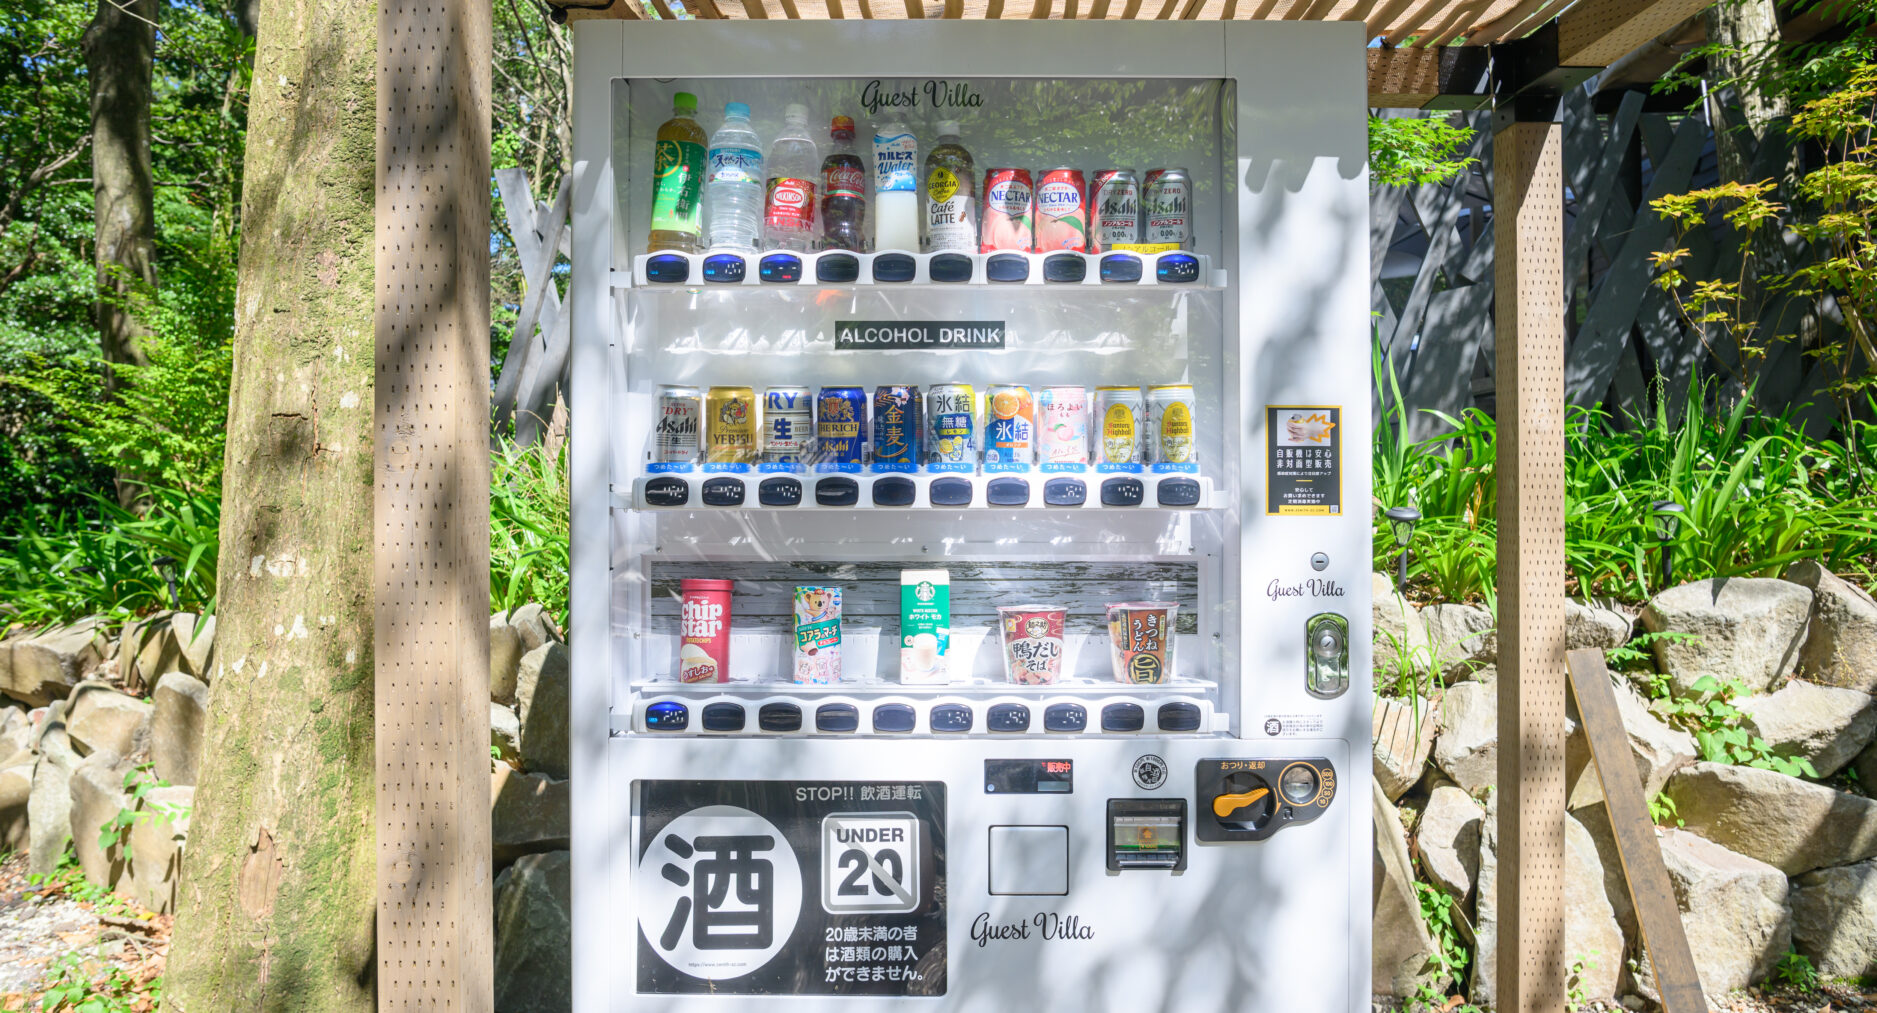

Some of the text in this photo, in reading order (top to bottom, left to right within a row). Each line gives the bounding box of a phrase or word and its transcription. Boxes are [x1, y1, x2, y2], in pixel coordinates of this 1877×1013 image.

[861, 80, 984, 114] Guest Villa
[715, 154, 750, 168] 天然水
[878, 151, 913, 161] カルピス
[878, 161, 914, 175] Water
[929, 180, 957, 190] GEORGIA
[774, 191, 803, 202] WILKINSON
[991, 191, 1030, 203] NECTAR
[1038, 192, 1083, 203] NECTAR
[930, 201, 954, 214] Café
[1099, 198, 1137, 215] Asahi
[1147, 196, 1186, 216] Asahi
[930, 214, 956, 225] LATTE
[840, 328, 1000, 343] ALCOHOL DRINK
[936, 394, 970, 413] 氷結
[1047, 403, 1083, 411] ほろよい
[656, 416, 697, 434] Asahi
[773, 418, 792, 439] 生
[832, 424, 858, 432] RICH
[885, 405, 904, 446] 金麦
[942, 416, 967, 428] 無糖
[996, 421, 1029, 440] 氷結
[671, 437, 682, 445] 生
[713, 434, 753, 445] YEBISU
[822, 440, 849, 451] Asahi
[1277, 448, 1332, 459] 自販機は安心
[1276, 459, 1332, 469] 非対面型販売
[1266, 579, 1346, 601] Guest Villa
[681, 600, 723, 620] chip
[681, 620, 723, 637] star
[1133, 619, 1144, 652] うどん
[1146, 614, 1158, 651] きつね
[1013, 641, 1059, 659] 鴨だし
[1026, 660, 1047, 672] そば
[1266, 720, 1280, 734] 酒
[1220, 761, 1266, 770] おつり・返却
[795, 785, 922, 801] STOP!! 飲酒運転
[836, 827, 904, 844] UNDER
[837, 848, 904, 897] 20
[660, 833, 775, 951] 酒
[825, 926, 918, 942] 20歳未満の者
[970, 912, 1095, 948] Guest Villa
[825, 945, 919, 963] は酒類の購入
[825, 966, 923, 983] ができません。
